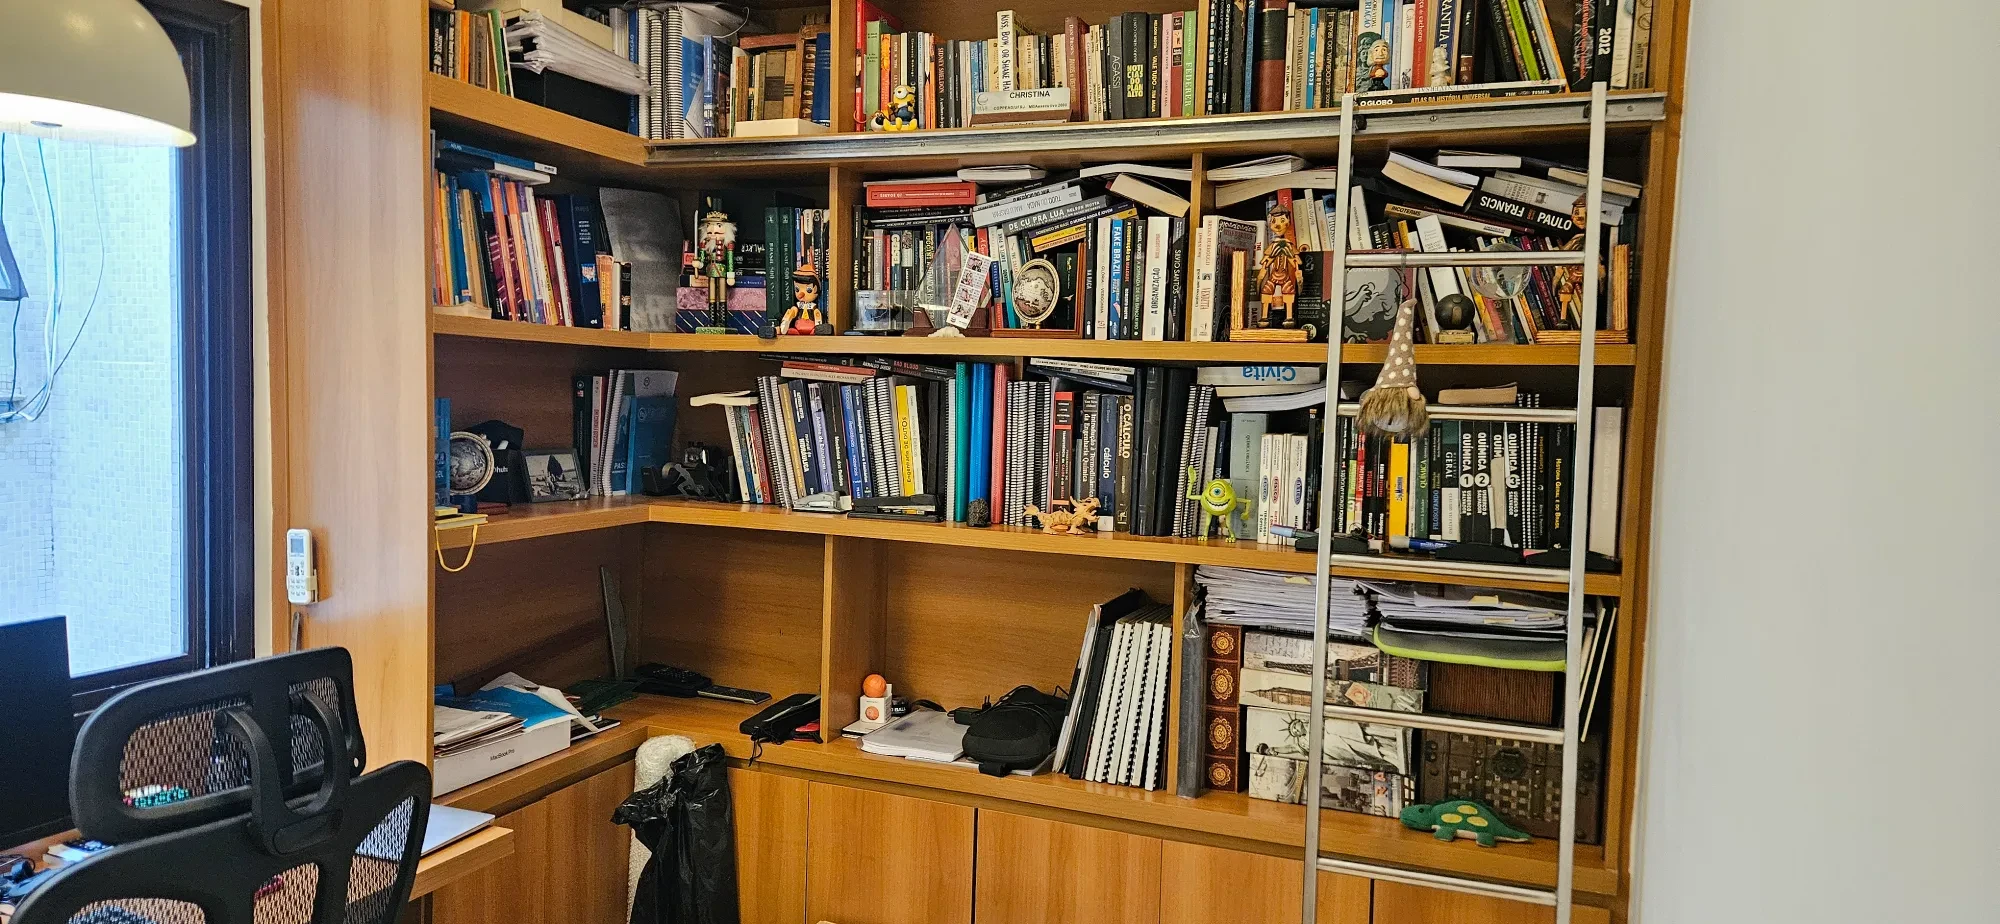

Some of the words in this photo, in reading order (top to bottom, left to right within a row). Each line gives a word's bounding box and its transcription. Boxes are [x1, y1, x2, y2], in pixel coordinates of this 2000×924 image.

[1001, 15, 1010, 29] KISS,
[1001, 32, 1010, 47] BOW,
[1598, 28, 1612, 55] 2012
[1002, 50, 1009, 58] OR
[1112, 55, 1120, 88] AGASSI
[1391, 205, 1422, 216] INCOTERMS
[1480, 196, 1524, 218] FRANCIS
[1008, 220, 1019, 230] DE
[1020, 218, 1031, 227] CU
[1032, 214, 1048, 224] PRA
[1050, 210, 1064, 220] LUA
[1537, 212, 1572, 231] PAULO
[1242, 366, 1296, 381] Civita
[1122, 414, 1132, 458] CÁLCULO
[1493, 435, 1504, 458] QUÍM
[1462, 433, 1471, 472] QUÍMICA
[1477, 432, 1488, 470] QUÍMICA
[1508, 433, 1519, 472] QUÍMICA
[1103, 447, 1112, 479] cálculo
[1419, 460, 1427, 488] QUÍMICA
[1478, 475, 1485, 485] 2
[1510, 476, 1516, 486] 3
[490, 750, 508, 761] MacBook
